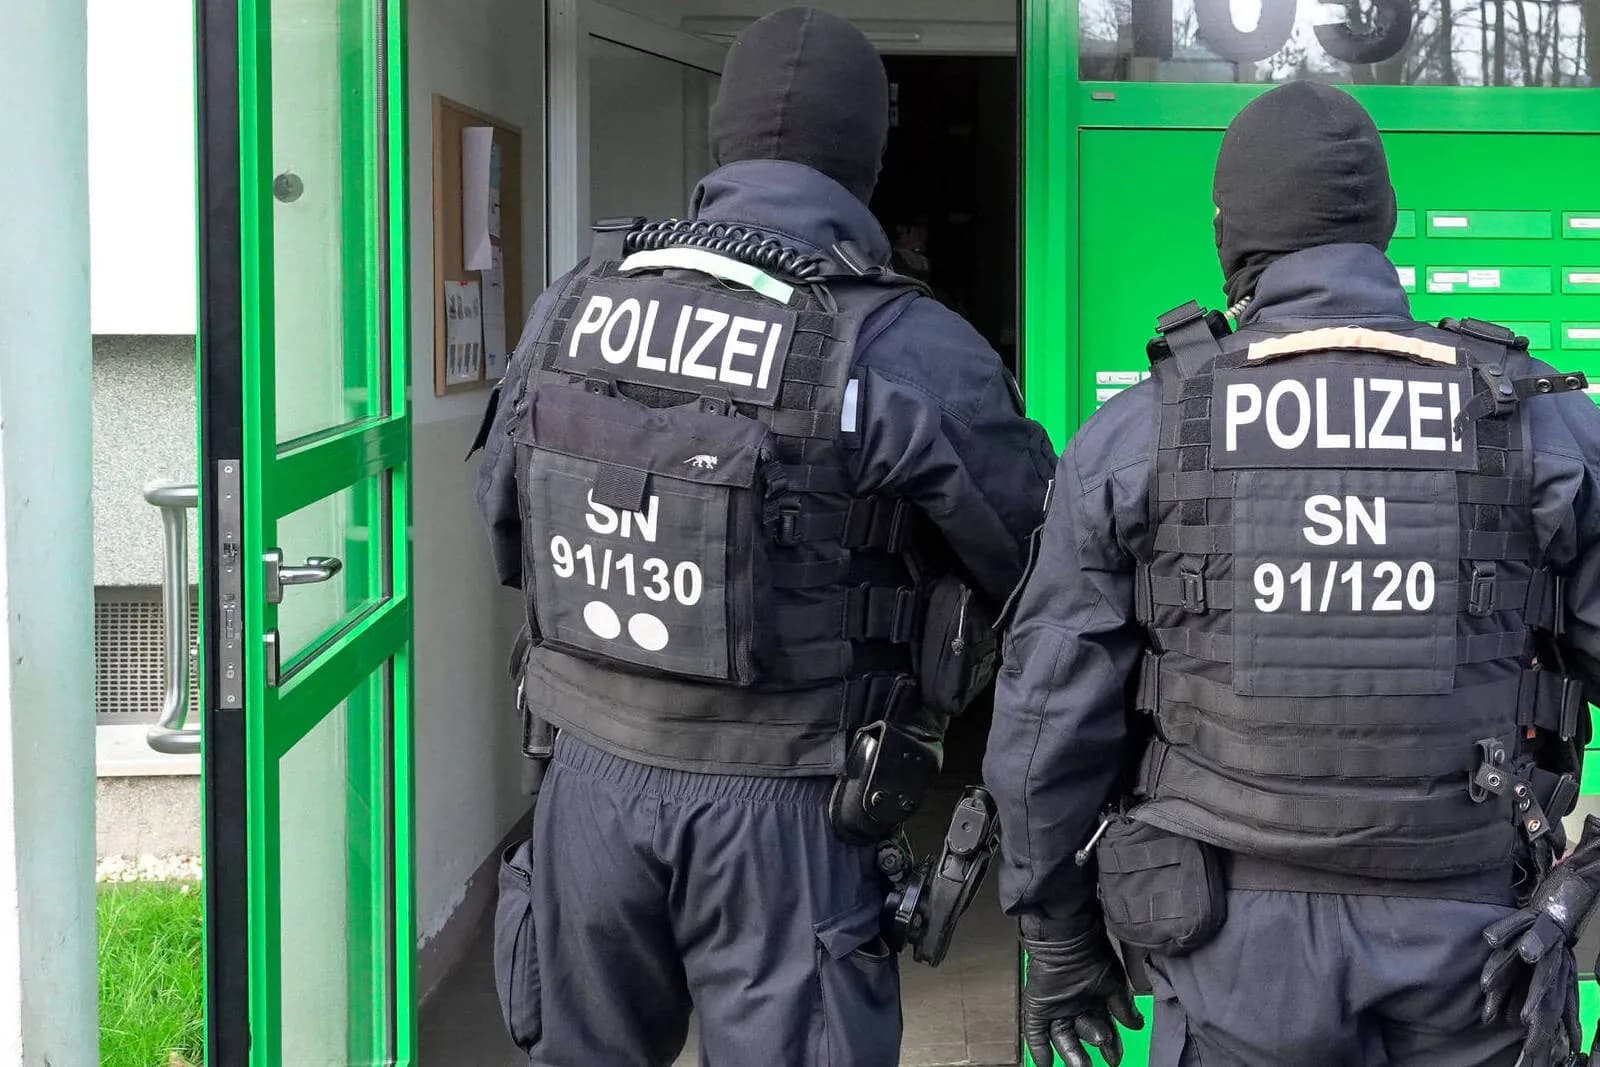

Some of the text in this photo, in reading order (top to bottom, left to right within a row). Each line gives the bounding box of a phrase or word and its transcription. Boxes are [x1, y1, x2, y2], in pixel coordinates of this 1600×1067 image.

[568, 295, 783, 390] POLIZEI
[1225, 377, 1463, 453] POLIZEI
[585, 487, 660, 543] SN
[1302, 494, 1387, 546] SN
[550, 534, 703, 606] 91/130
[1253, 560, 1435, 613] 91/120
